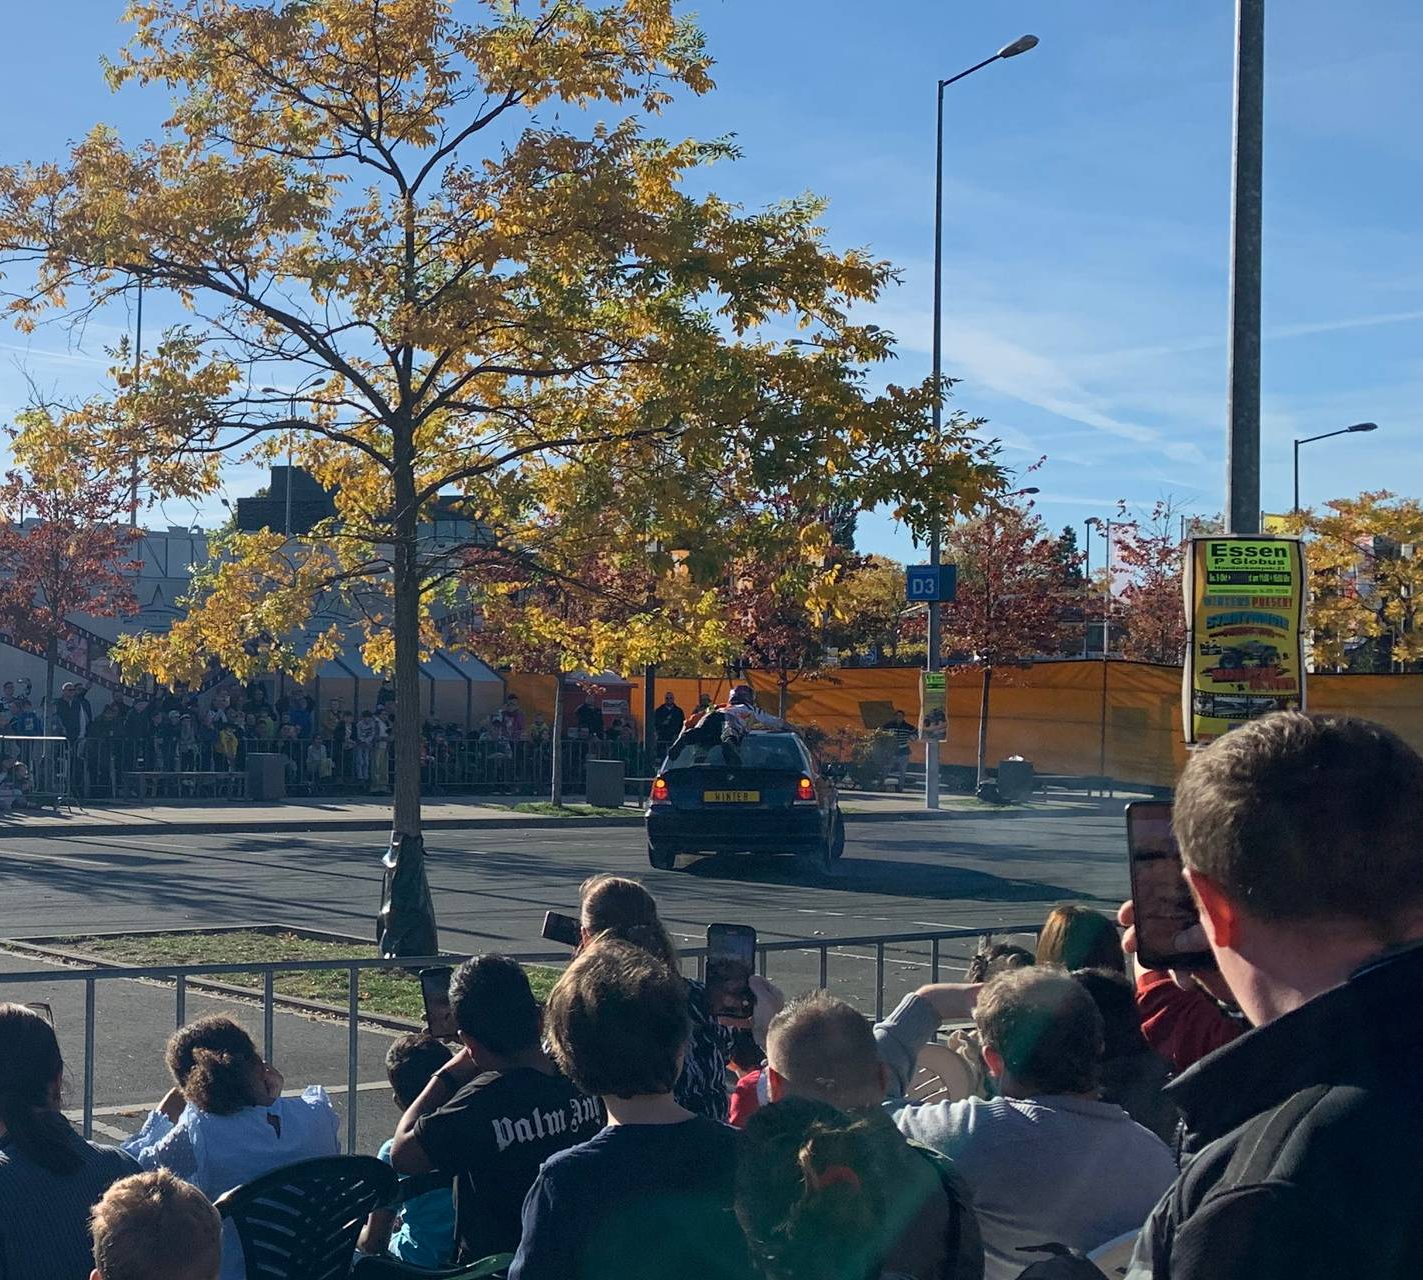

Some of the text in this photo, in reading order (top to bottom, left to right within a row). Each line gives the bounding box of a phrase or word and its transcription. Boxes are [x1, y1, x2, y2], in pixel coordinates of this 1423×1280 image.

[1211, 543, 1287, 557] Essen
[1231, 557, 1285, 565] Globus
[912, 578, 935, 595] D3
[714, 791, 748, 801] WINTER
[491, 1107, 567, 1152] Palm
